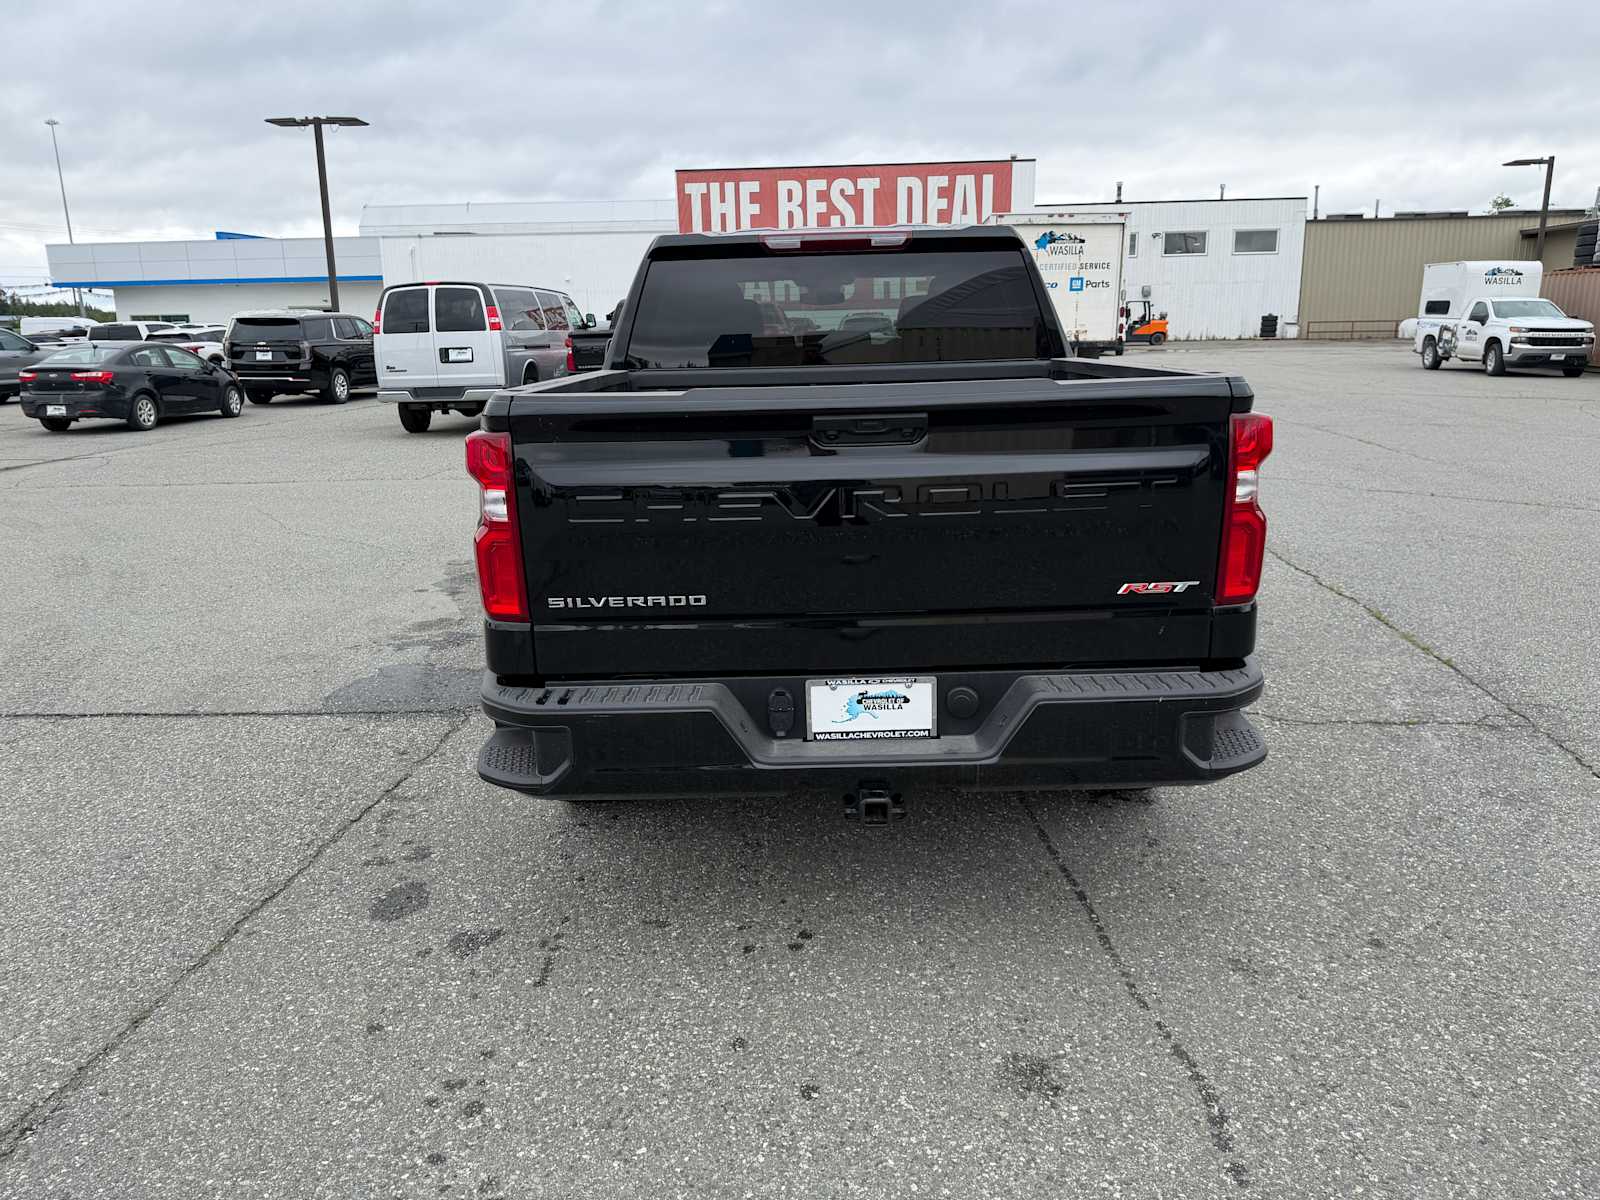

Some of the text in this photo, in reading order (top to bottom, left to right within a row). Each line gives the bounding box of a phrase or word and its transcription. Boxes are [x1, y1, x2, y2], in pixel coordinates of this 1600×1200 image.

[684, 180, 760, 232] THE
[777, 177, 881, 230] BEST
[1049, 245, 1084, 256] WASILLA
[1079, 262, 1111, 270] SERVICE
[1085, 279, 1110, 288] Parts
[1484, 276, 1522, 285] WASILLA
[1116, 580, 1201, 595] RST
[547, 595, 707, 608] SILVERADO
[863, 703, 903, 711] WASILLA
[815, 730, 929, 740] WASILLACHEVROLET.COM
